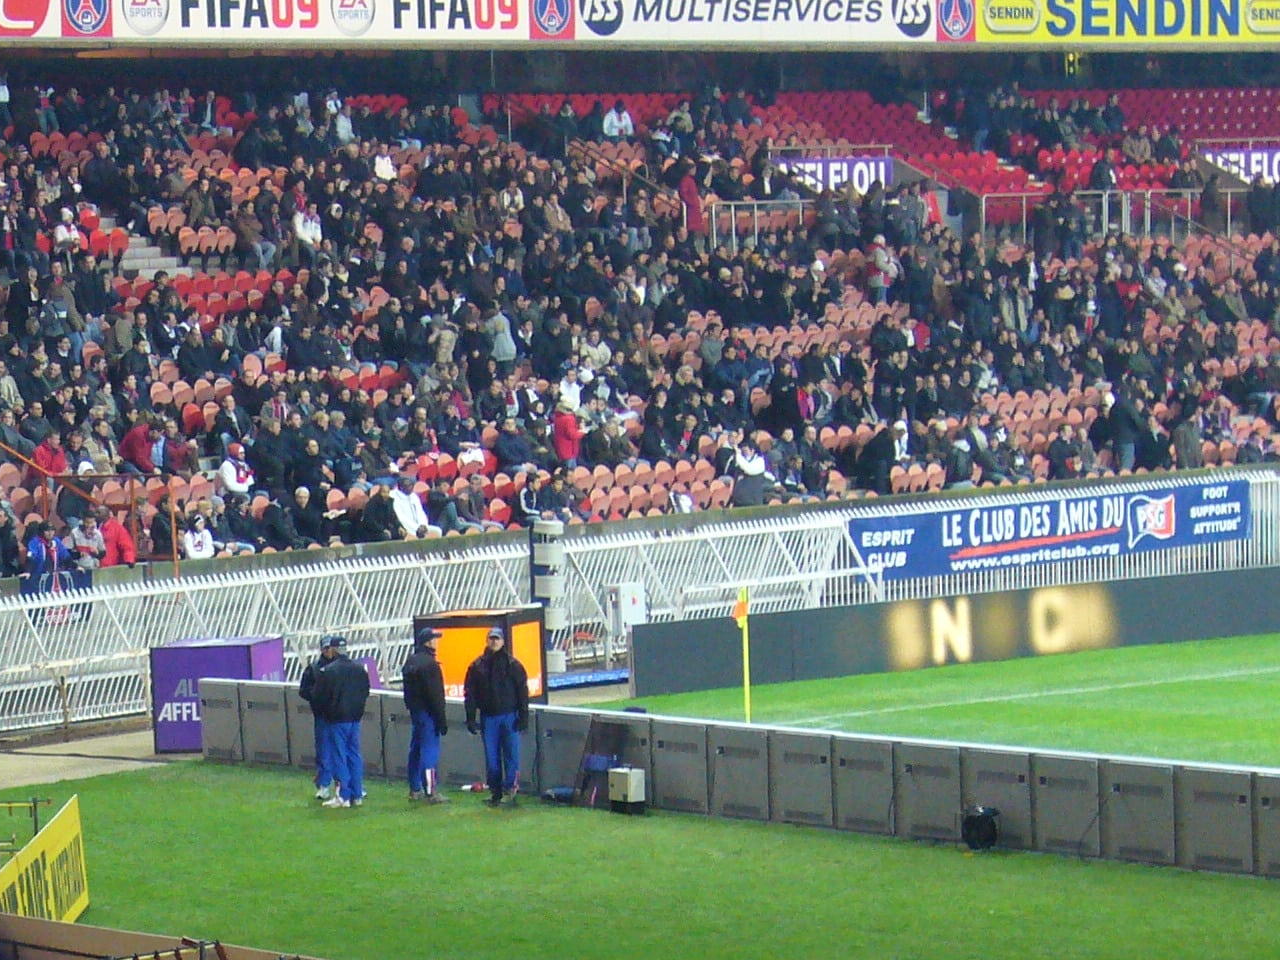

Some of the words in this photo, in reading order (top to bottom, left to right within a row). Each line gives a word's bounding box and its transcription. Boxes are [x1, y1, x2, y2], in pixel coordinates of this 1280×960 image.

[633, 0, 884, 23] MULTISERVICES
[988, 6, 1034, 20] SENDIN
[1045, 0, 1239, 36] SENDIN
[1202, 486, 1229, 500] FOOT
[942, 513, 963, 547] LE
[1020, 504, 1051, 538] DES
[1102, 495, 1125, 530] DU
[1136, 502, 1166, 533] PSG
[862, 528, 915, 548] ESPRIT
[868, 551, 907, 569] CLUB
[950, 543, 1120, 571] www.espritclub.org
